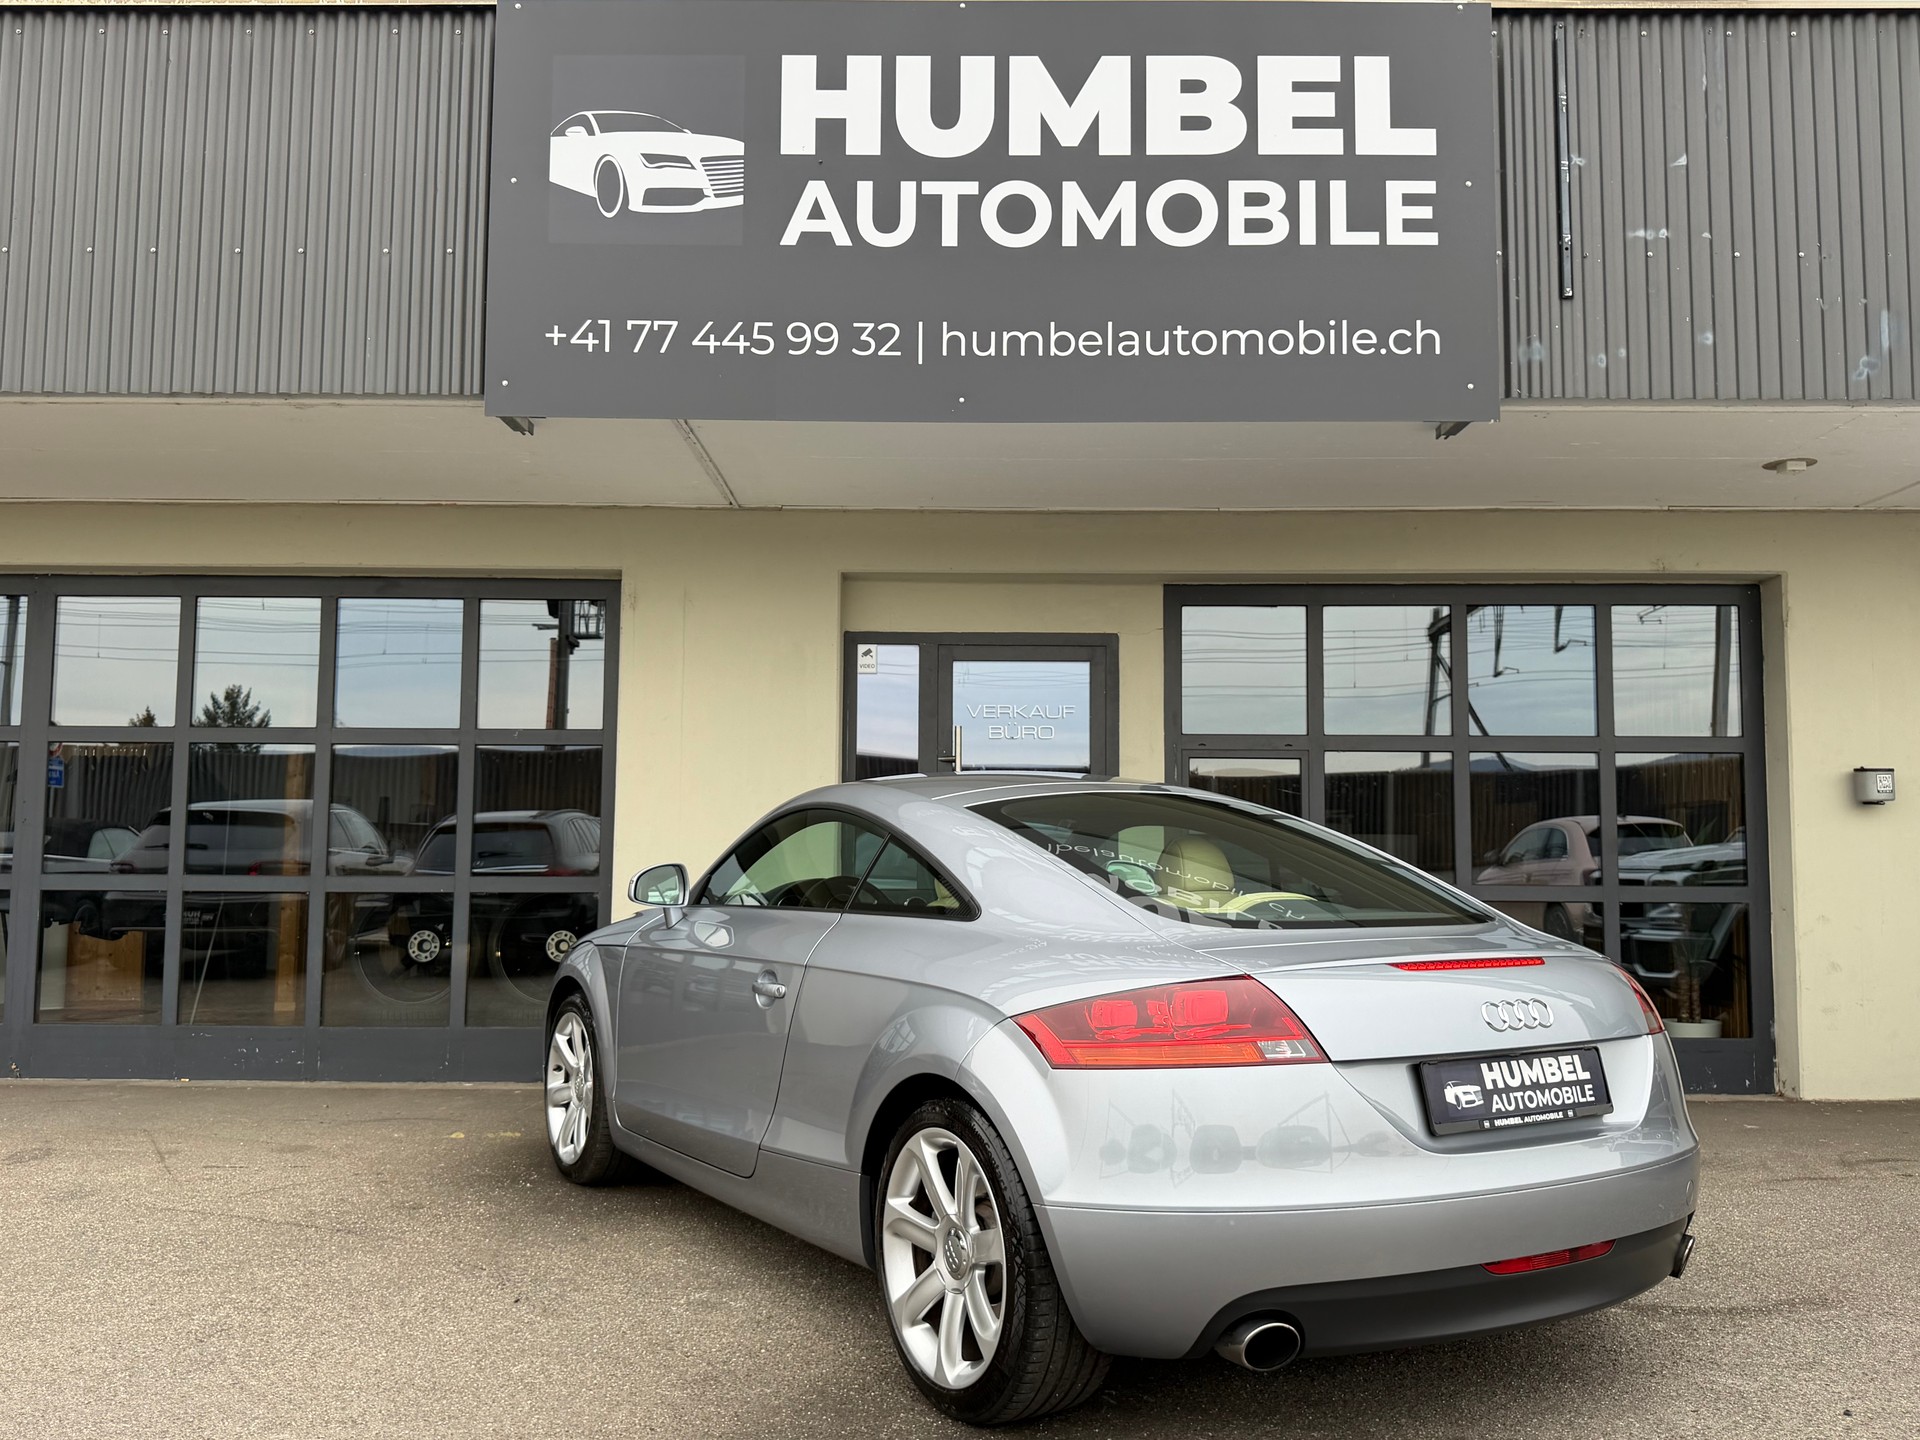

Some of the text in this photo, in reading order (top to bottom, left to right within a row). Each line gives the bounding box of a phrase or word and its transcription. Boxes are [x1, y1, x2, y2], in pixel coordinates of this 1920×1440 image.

[780, 54, 1437, 159] HUMBEL
[779, 179, 1439, 248] AUTOMOBILE
[544, 319, 611, 353] +41
[627, 319, 679, 354] 77
[691, 321, 775, 356] 445
[787, 321, 839, 356] 99
[851, 322, 902, 357] 32
[942, 319, 1441, 357] humbelautomobile.ch
[966, 704, 1076, 719] VERKAUF
[988, 721, 1056, 740] BÜRO
[1480, 1054, 1591, 1091] HUMBEL
[1491, 1084, 1596, 1113] AUTOMOBILE
[1494, 1111, 1564, 1127] HUMBEL AUTOMOBILE
